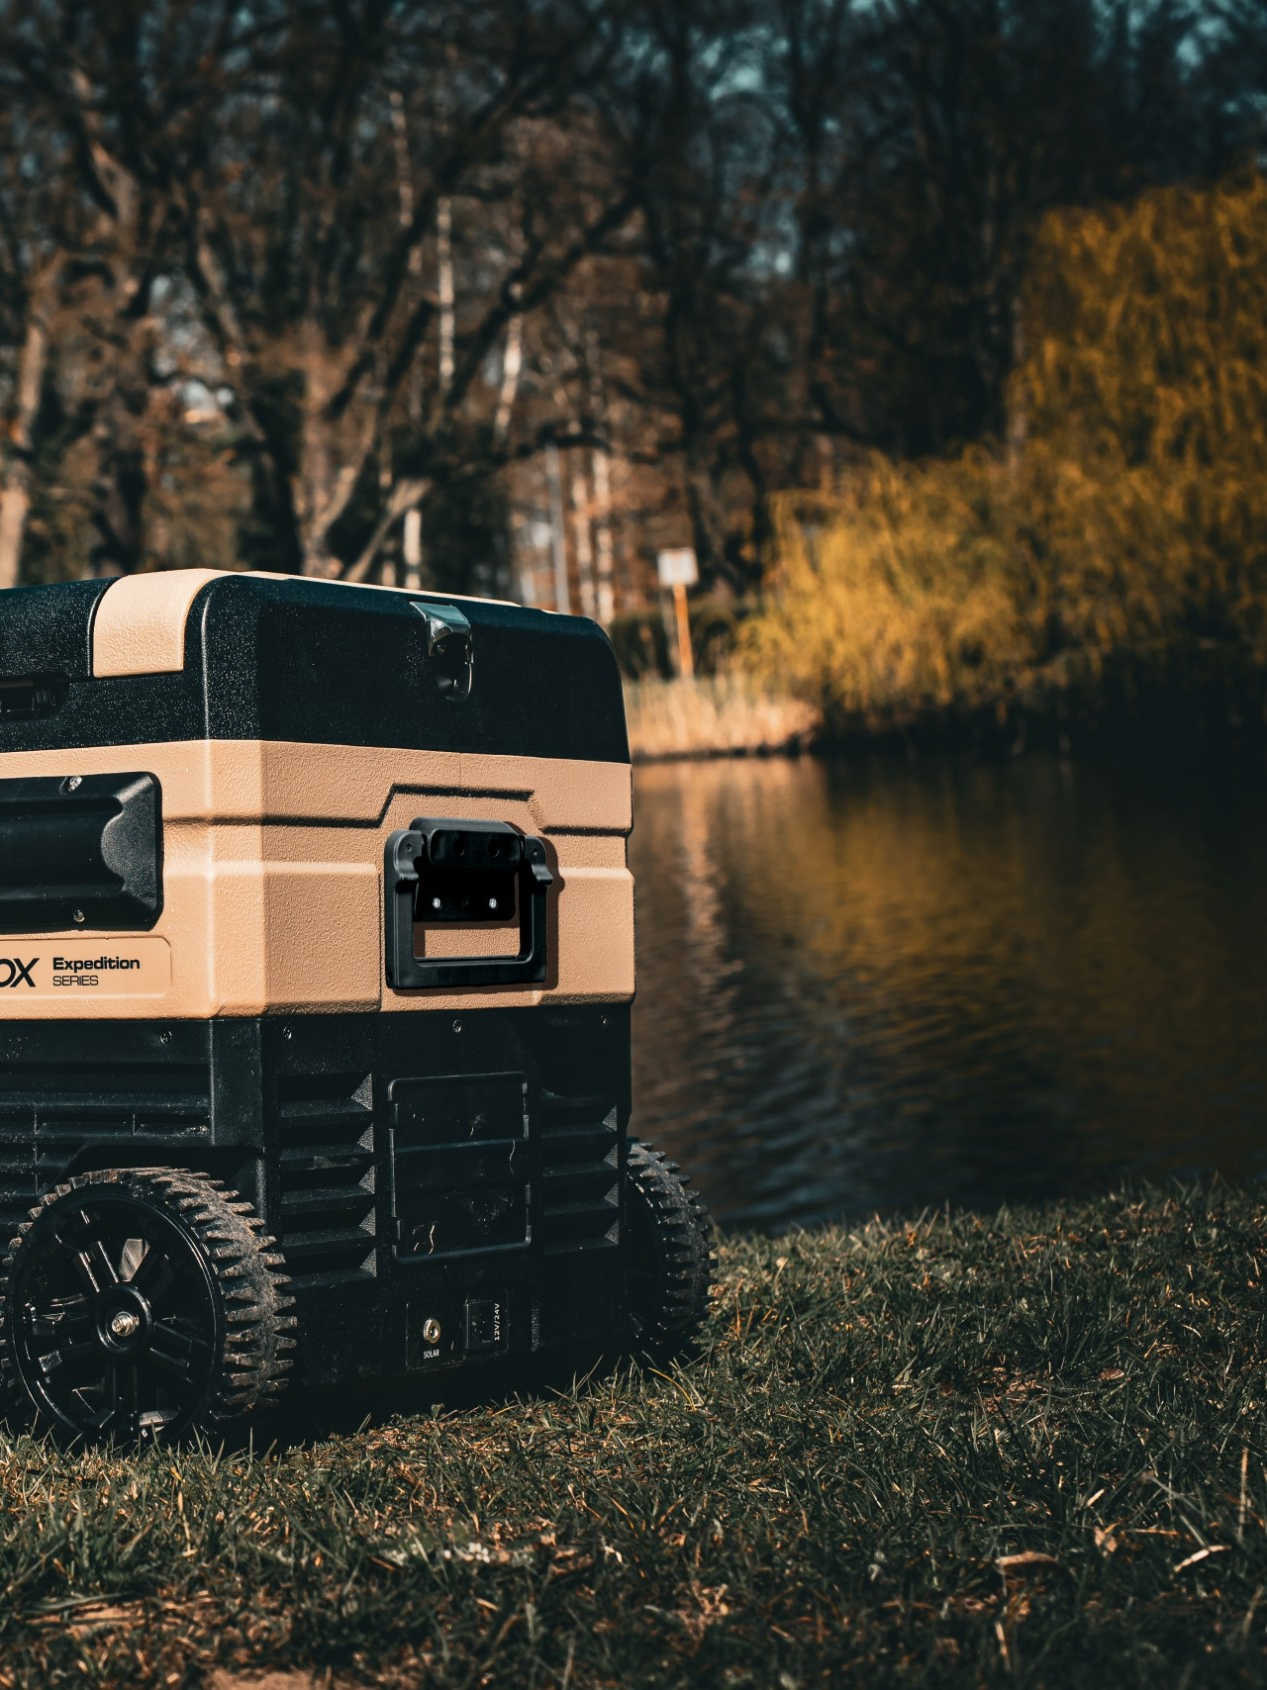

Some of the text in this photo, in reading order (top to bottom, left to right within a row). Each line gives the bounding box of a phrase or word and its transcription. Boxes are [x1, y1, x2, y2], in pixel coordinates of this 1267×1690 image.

[52, 956, 141, 975] Expedition
[52, 975, 99, 987] SERIES
[423, 1349, 440, 1359] SOLAR
